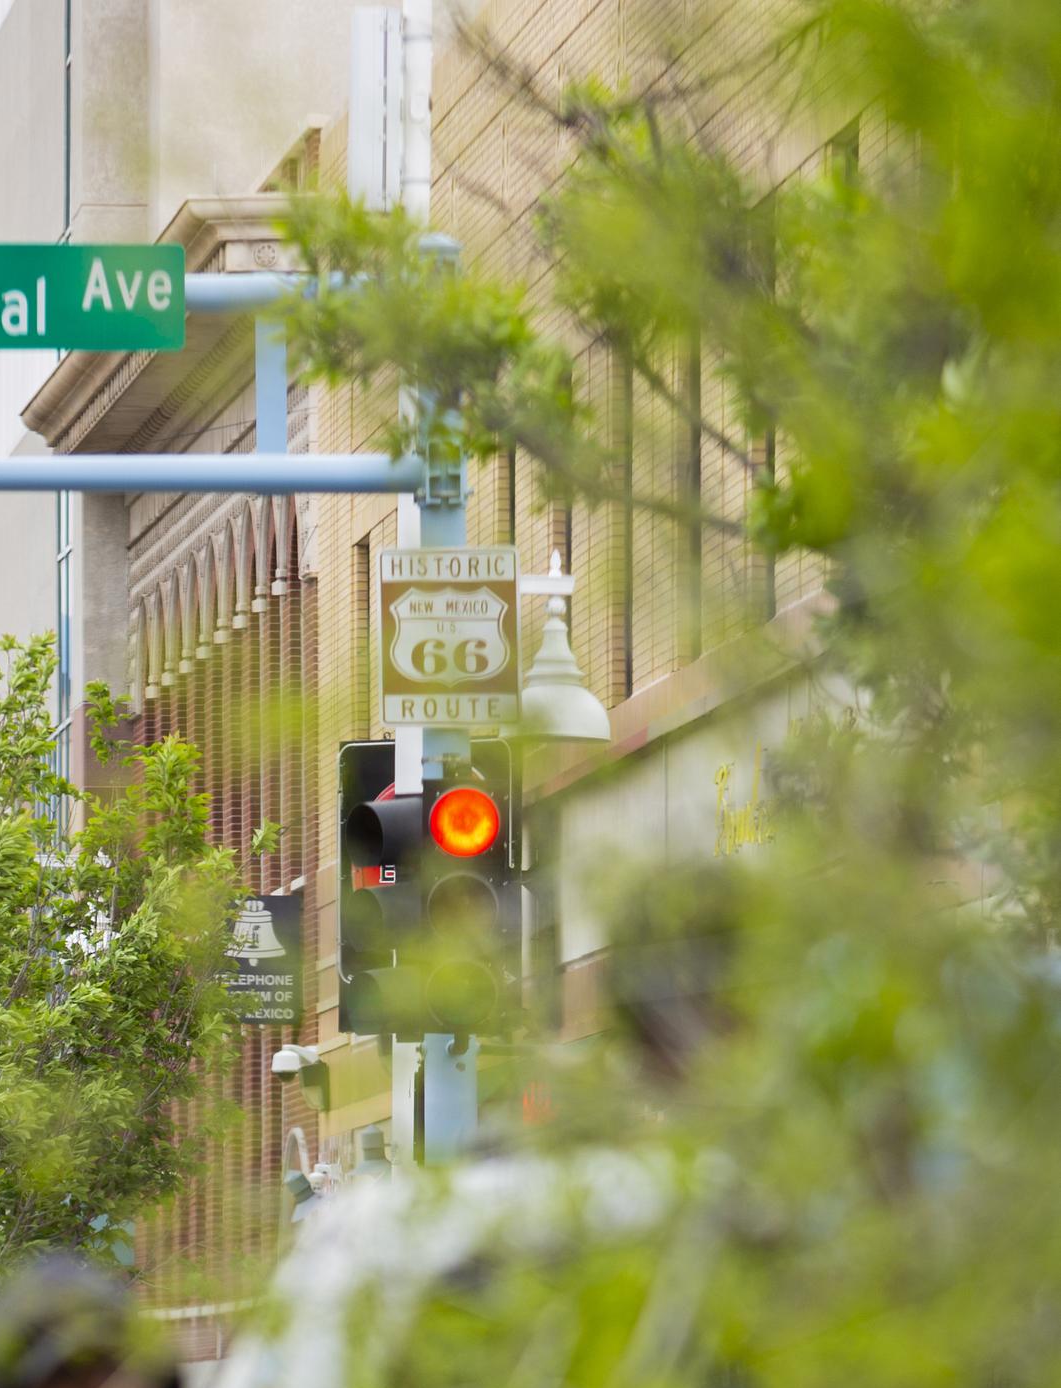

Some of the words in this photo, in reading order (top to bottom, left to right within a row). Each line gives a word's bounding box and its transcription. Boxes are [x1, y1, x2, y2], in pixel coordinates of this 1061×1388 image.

[81, 257, 173, 312] Ave
[391, 557, 505, 577] HISTORIC
[409, 600, 434, 614] NEW
[445, 599, 488, 615] MEXICO
[410, 639, 489, 675] 66
[401, 697, 501, 720] ROUTE
[274, 991, 293, 1002] OF
